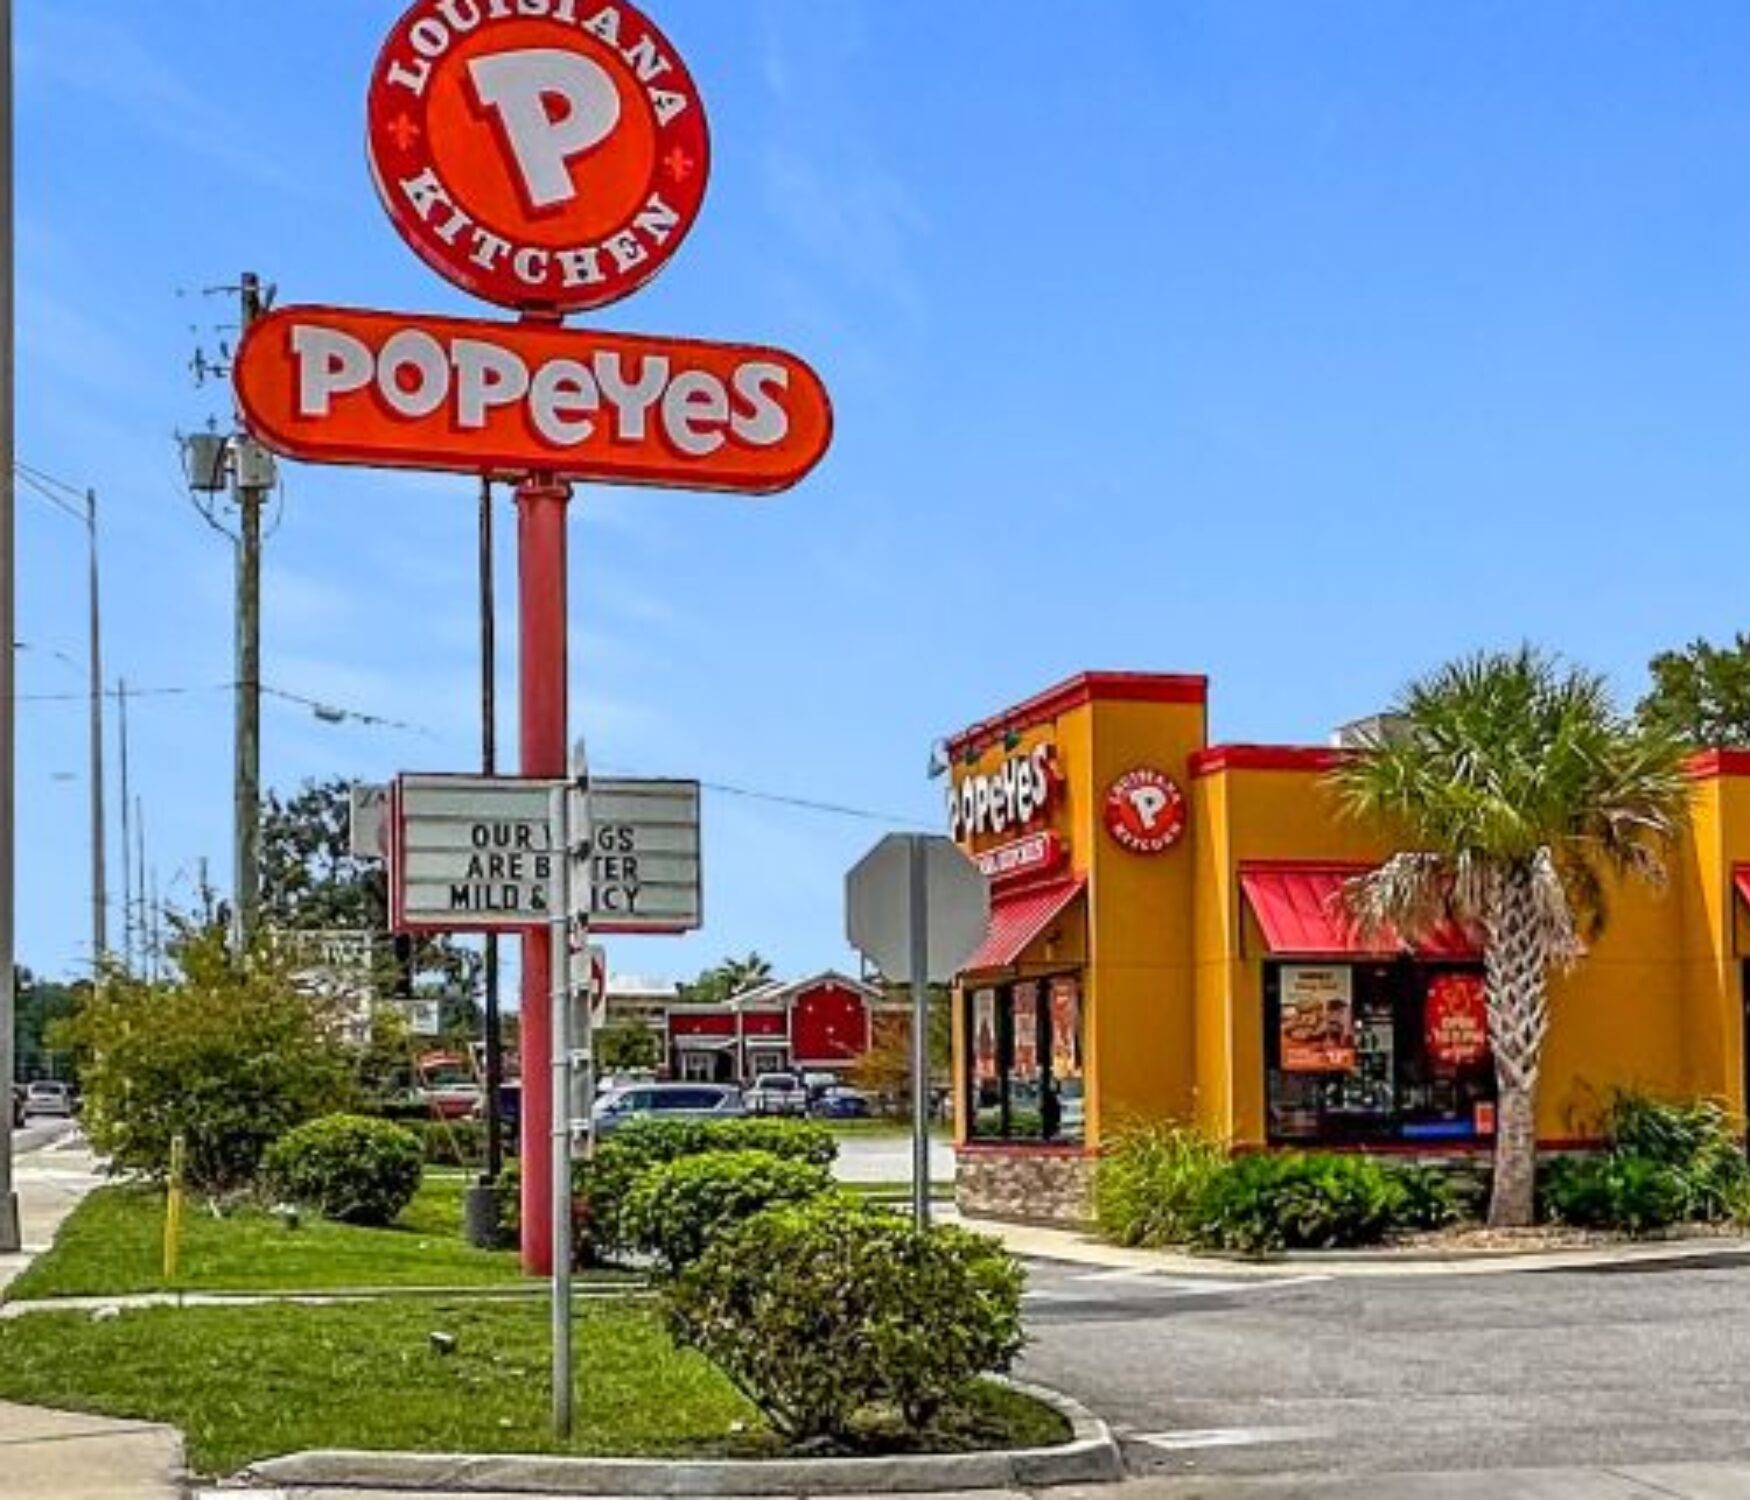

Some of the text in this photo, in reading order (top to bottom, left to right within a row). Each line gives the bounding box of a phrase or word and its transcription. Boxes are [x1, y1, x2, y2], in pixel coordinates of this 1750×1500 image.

[467, 48, 621, 208] P
[399, 168, 680, 288] KITCHEN
[291, 324, 790, 456] POPeYeS
[1129, 786, 1167, 830] P
[472, 824, 532, 849] OUR
[467, 854, 639, 882] ARE BTER
[450, 884, 518, 911] MILD
[530, 885, 547, 910] &
